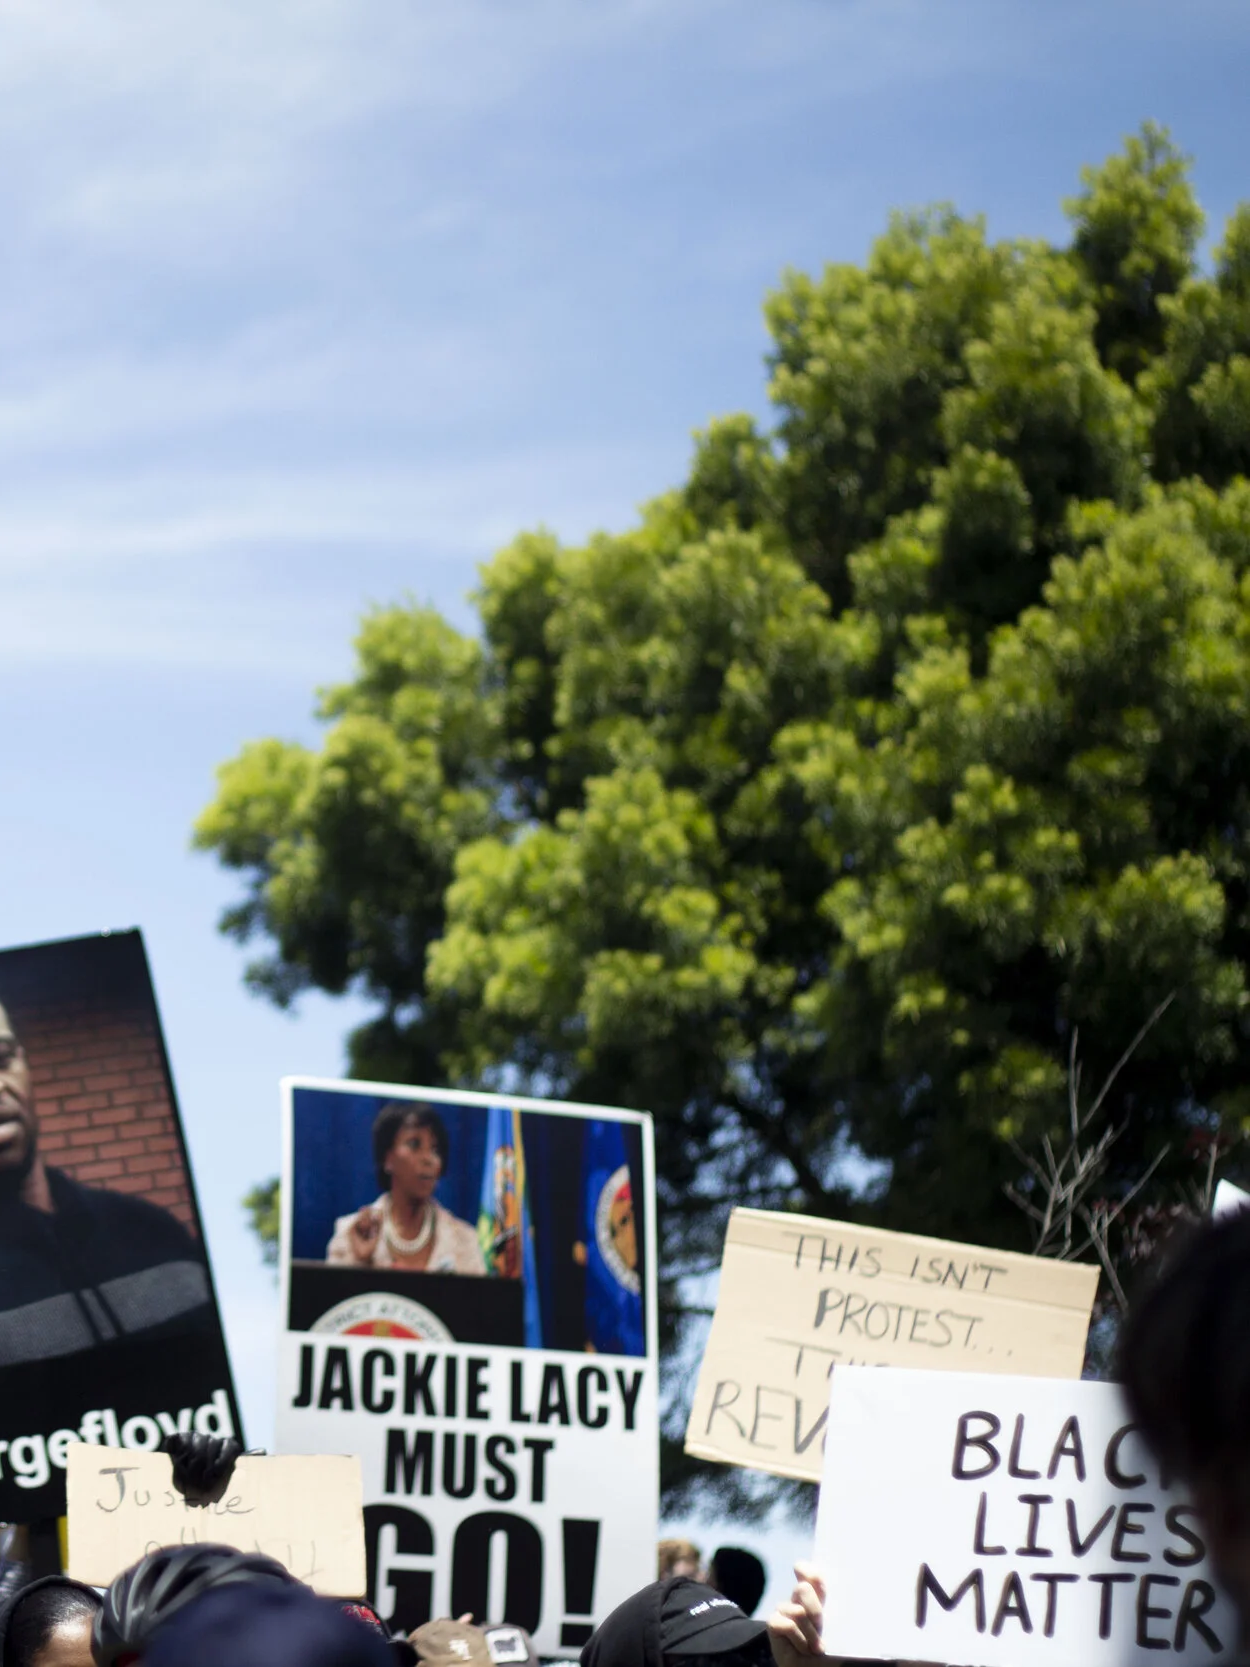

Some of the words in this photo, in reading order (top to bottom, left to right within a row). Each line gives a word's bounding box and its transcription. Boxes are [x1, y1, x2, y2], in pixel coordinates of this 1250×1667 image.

[782, 1231, 882, 1278] THIS
[910, 1255, 1008, 1290] ISN'T
[292, 1344, 490, 1420] JACKIE
[510, 1361, 645, 1431] LACY
[705, 1379, 830, 1456] REV
[385, 1429, 556, 1503] MUST
[951, 1410, 1170, 1490] BLAC
[96, 1466, 256, 1514] Jusce
[973, 1492, 1207, 1568] LIVES
[364, 1504, 602, 1648] GO!
[915, 1563, 1225, 1654] MATTER
